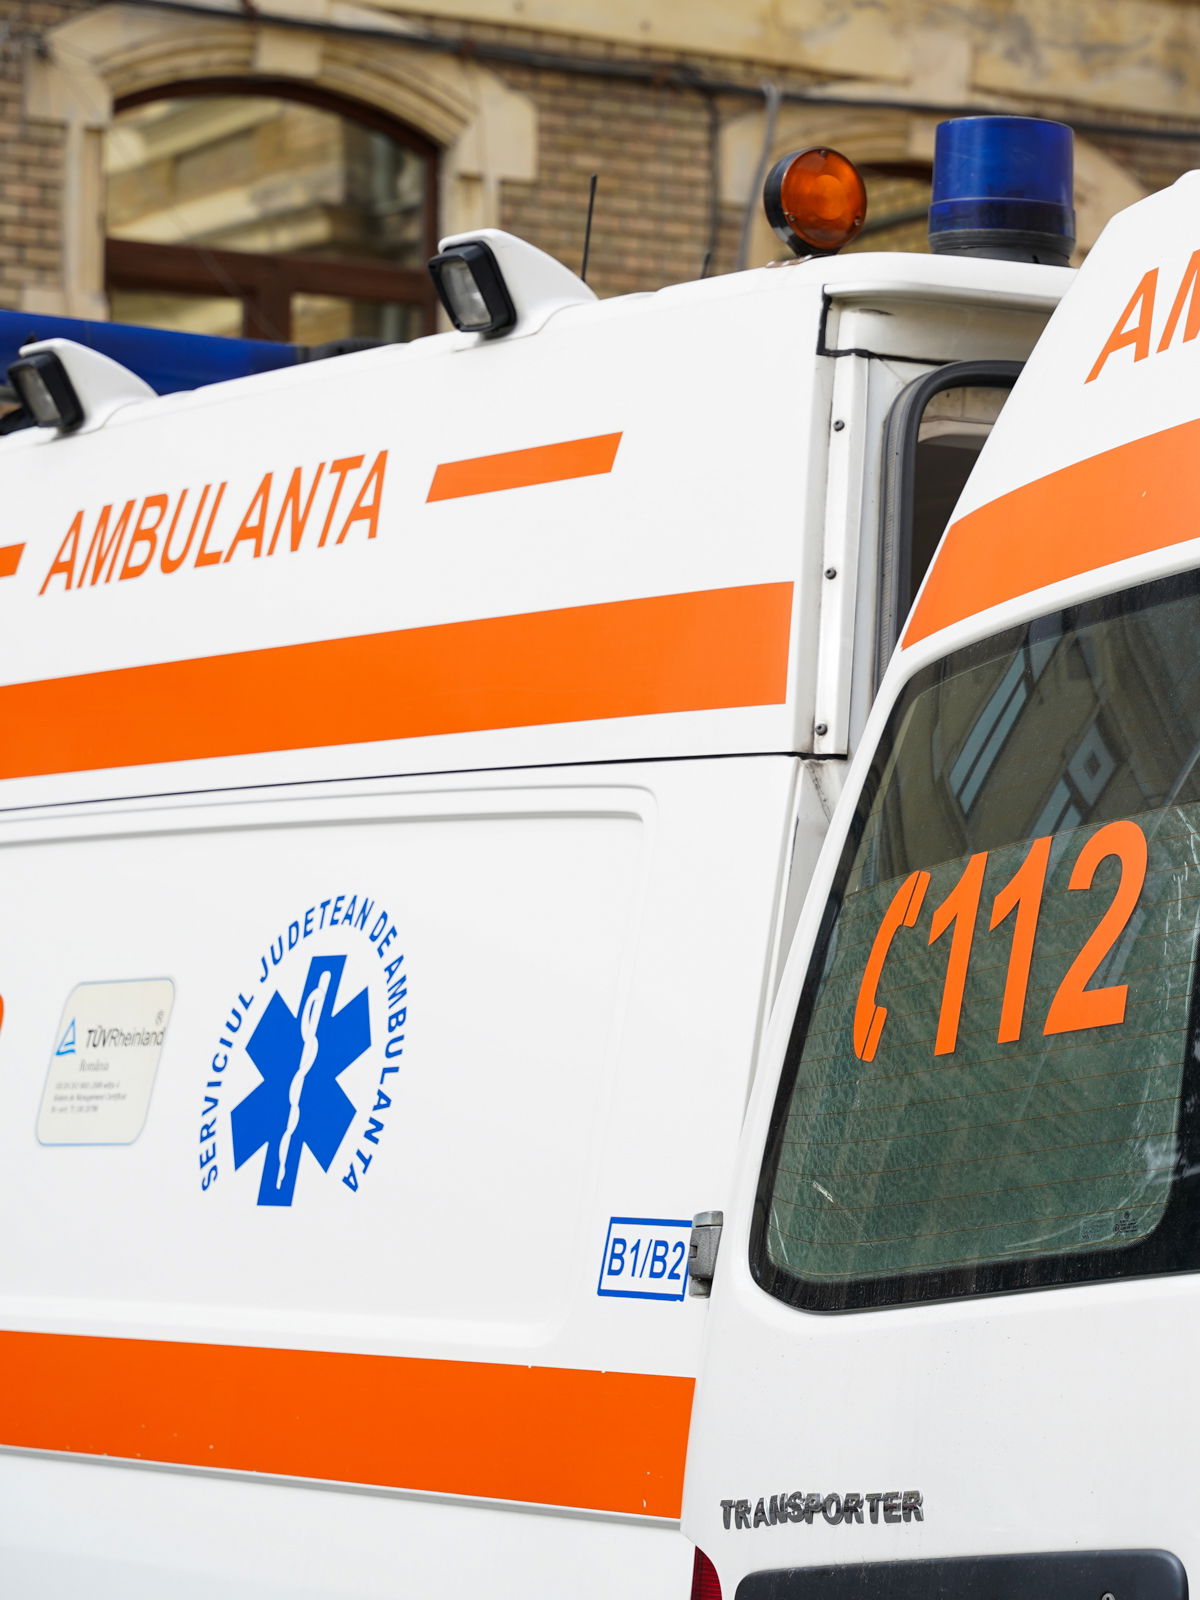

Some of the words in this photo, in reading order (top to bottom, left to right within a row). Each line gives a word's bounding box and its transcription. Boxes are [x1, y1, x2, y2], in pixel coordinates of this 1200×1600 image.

[38, 449, 389, 596] AMBULANTA
[259, 894, 375, 983] JUDETEAN
[368, 910, 398, 959] DE
[927, 819, 1149, 1057] 112
[199, 992, 255, 1191] SERVICIUL
[341, 954, 408, 1193] AMBULANTA
[606, 1237, 686, 1281] B1/B2
[720, 1490, 924, 1530] TRANSPORTER
